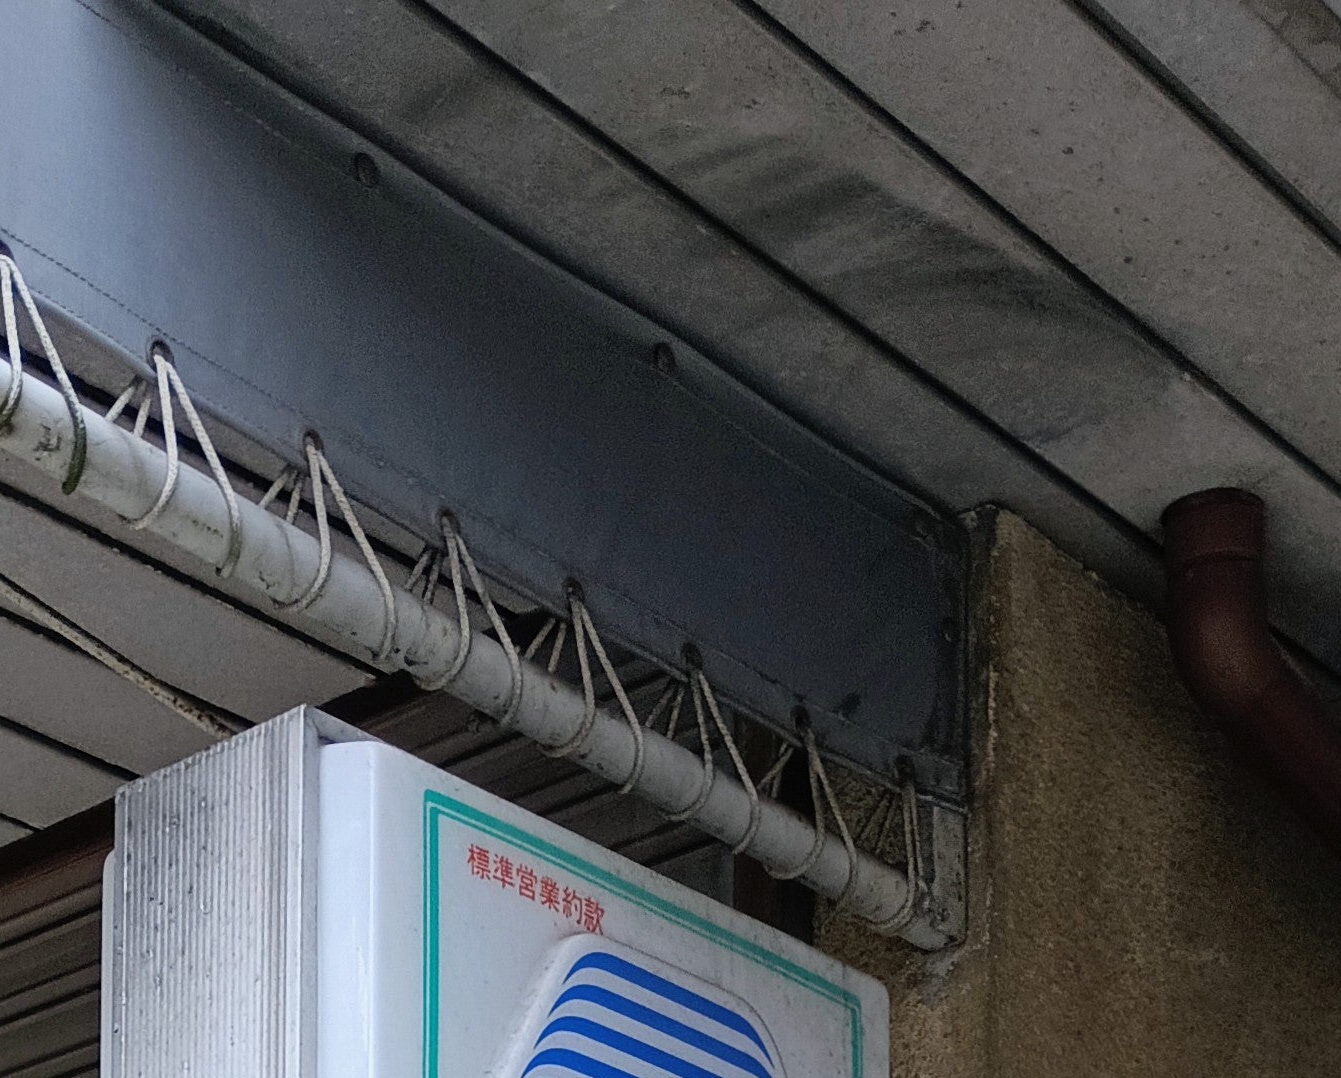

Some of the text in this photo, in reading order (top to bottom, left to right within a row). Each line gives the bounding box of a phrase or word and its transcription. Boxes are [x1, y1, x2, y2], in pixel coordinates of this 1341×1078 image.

[467, 843, 605, 935] 標準営業約款
